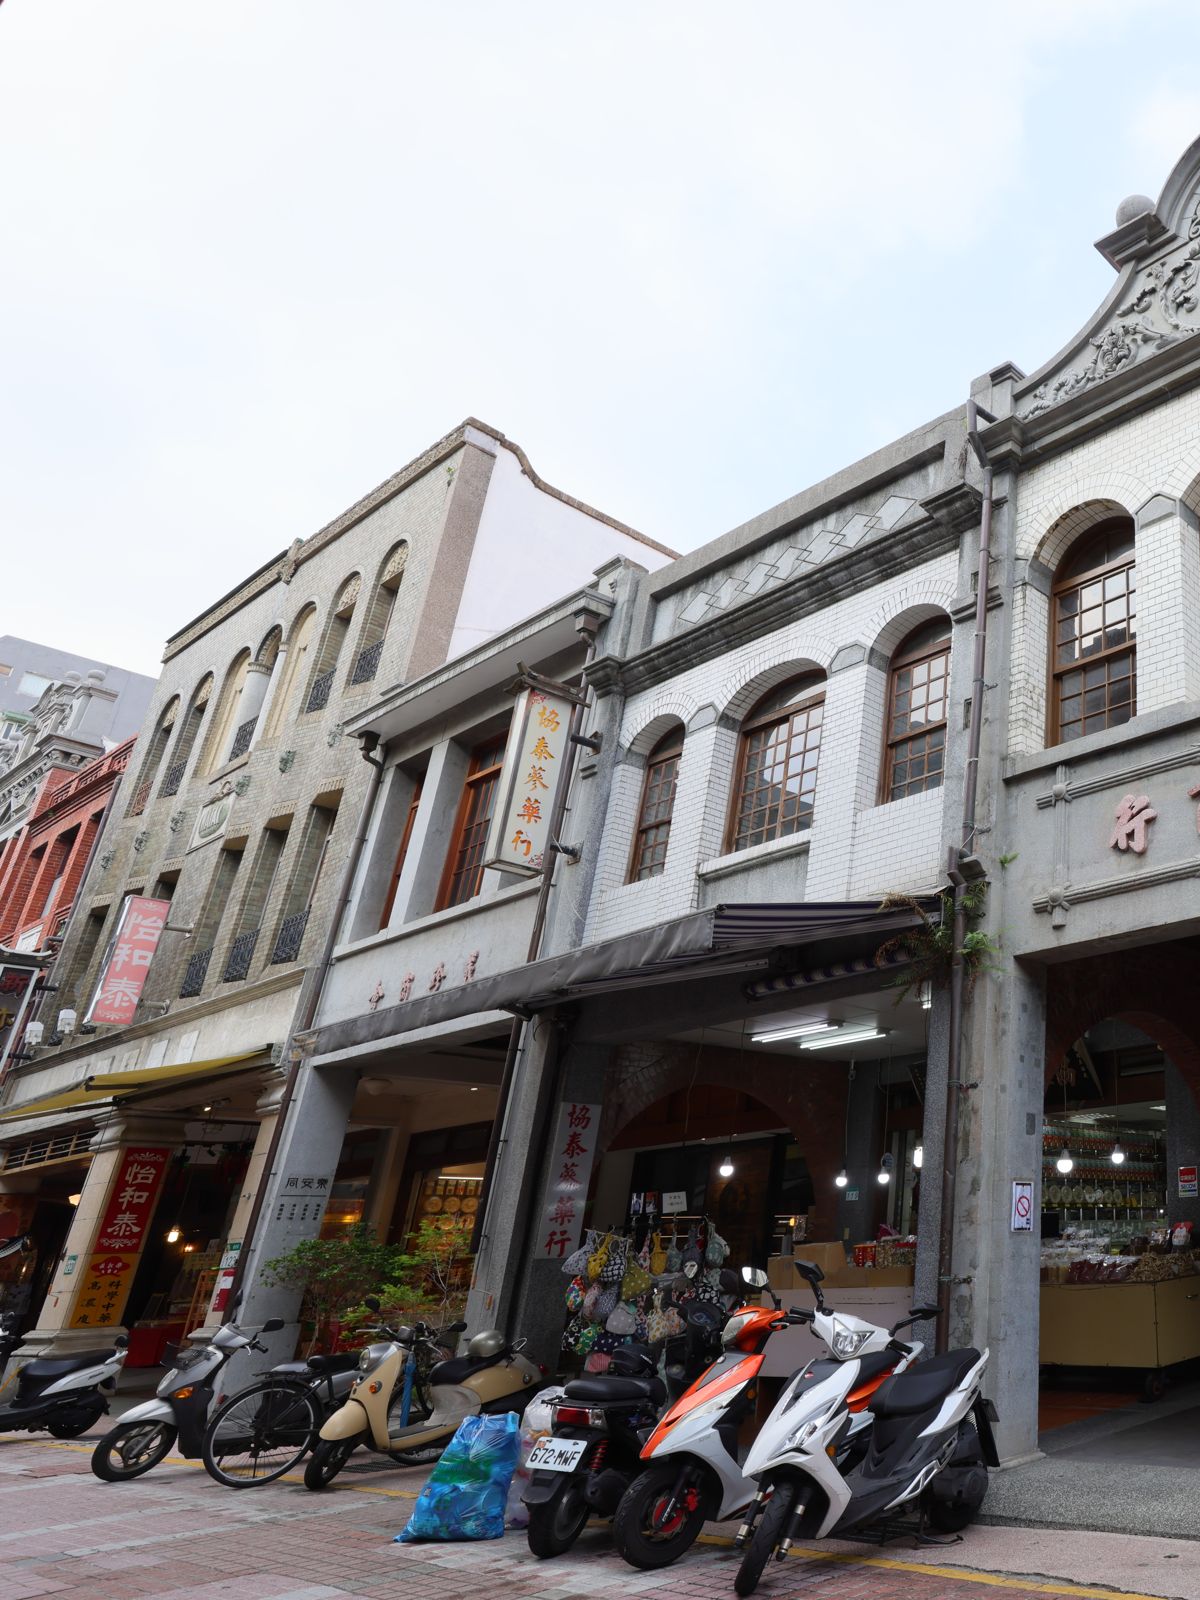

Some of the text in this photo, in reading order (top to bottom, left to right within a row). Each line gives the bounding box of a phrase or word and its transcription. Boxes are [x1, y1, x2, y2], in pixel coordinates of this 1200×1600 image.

[100, 912, 164, 1008] 怡和泰
[107, 1163, 157, 1237] 怡和泰
